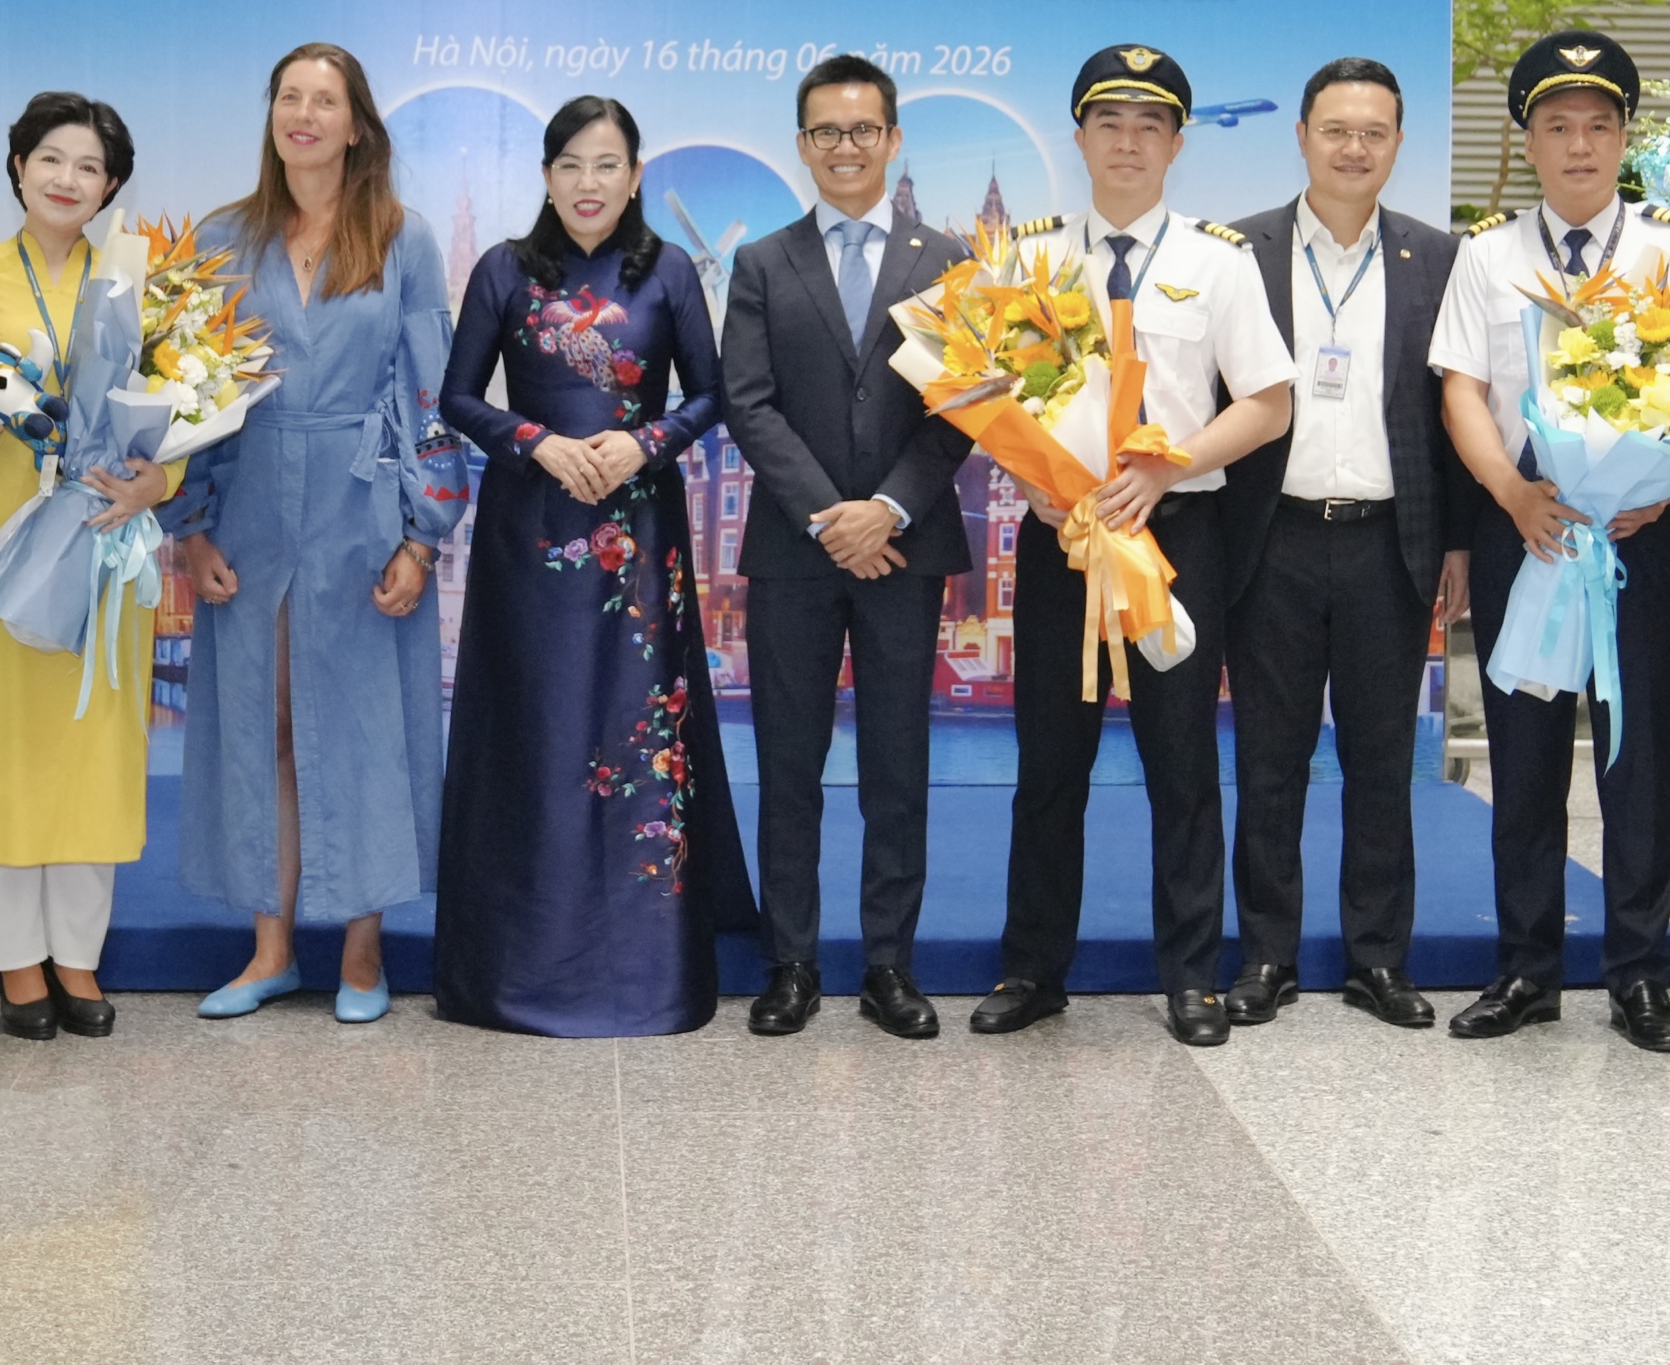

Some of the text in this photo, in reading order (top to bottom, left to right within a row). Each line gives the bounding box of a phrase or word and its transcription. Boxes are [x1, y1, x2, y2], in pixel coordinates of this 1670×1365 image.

[412, 34, 461, 66] Hà
[469, 36, 534, 74] Nội,
[544, 38, 630, 78] ngày
[642, 40, 679, 71] 16
[686, 38, 788, 81] tháng
[929, 44, 1013, 77] 2026
